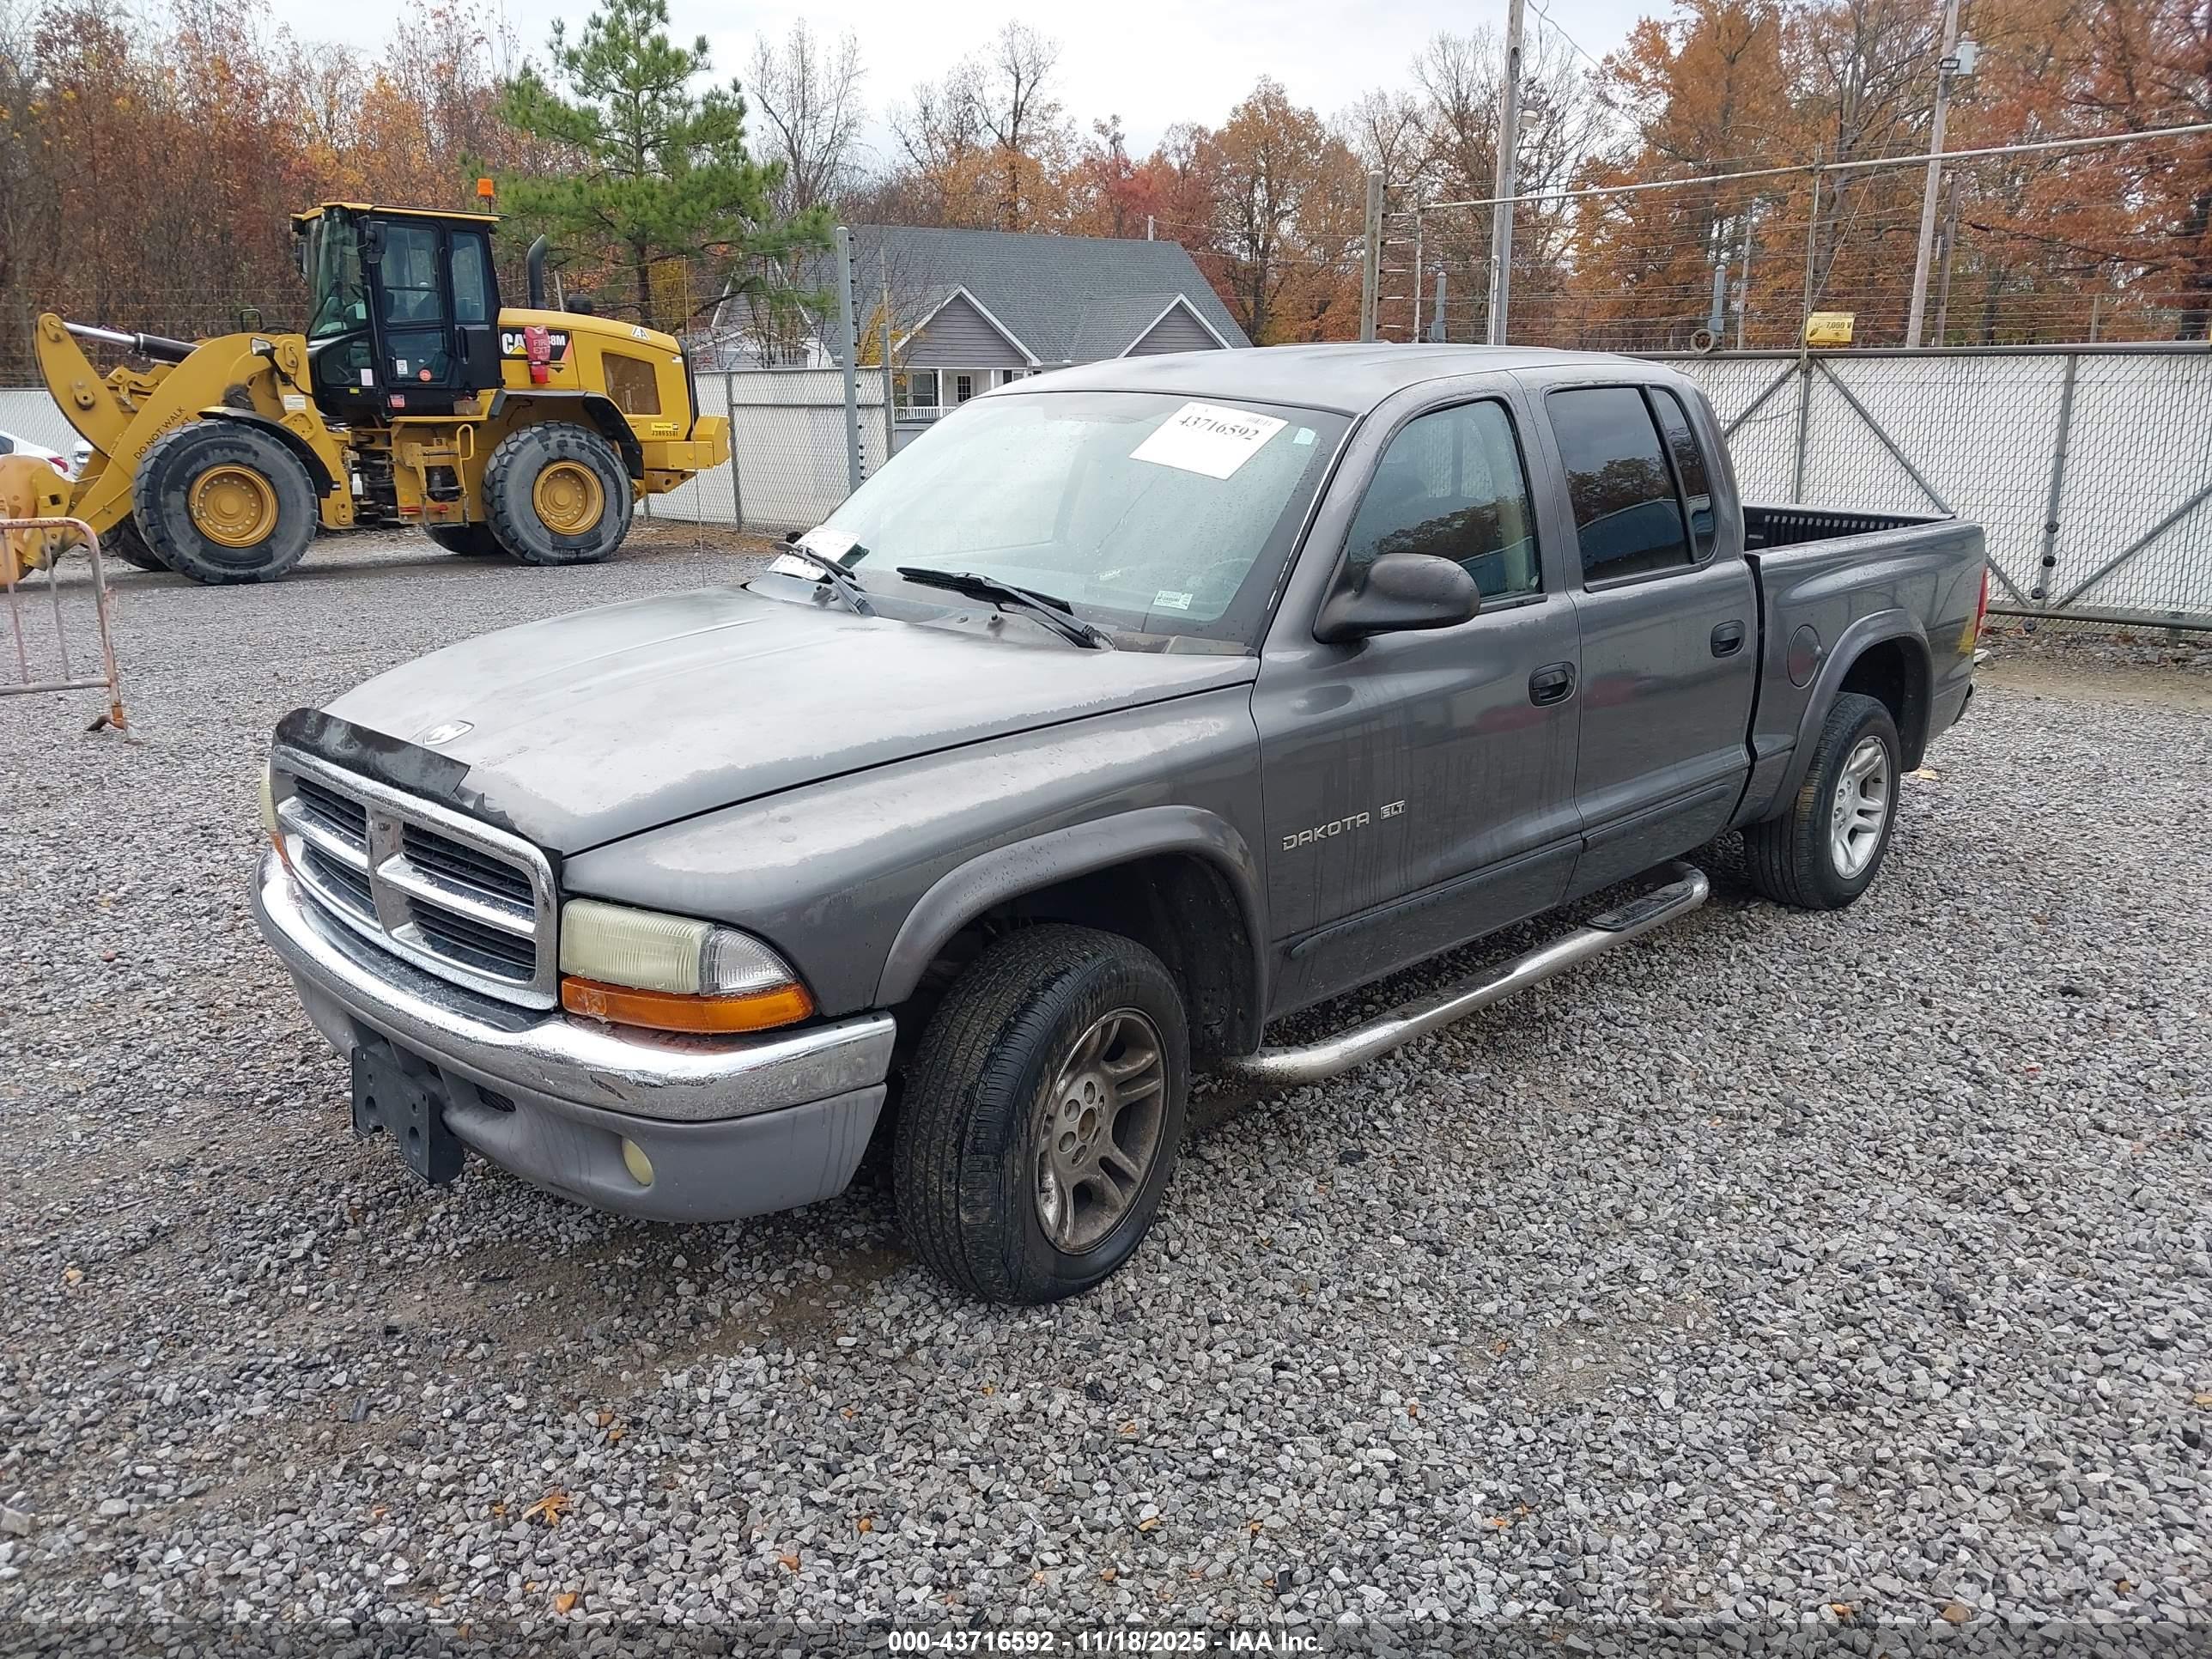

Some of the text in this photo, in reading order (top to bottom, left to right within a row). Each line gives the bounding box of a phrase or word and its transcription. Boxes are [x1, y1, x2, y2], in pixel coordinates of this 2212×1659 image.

[501, 333, 527, 355] CA
[133, 446, 148, 459] DO
[146, 428, 165, 447] NOT
[161, 406, 186, 428] WALK
[1179, 415, 1260, 441] 43716592
[1282, 800, 1406, 851] DAKOTA SLT
